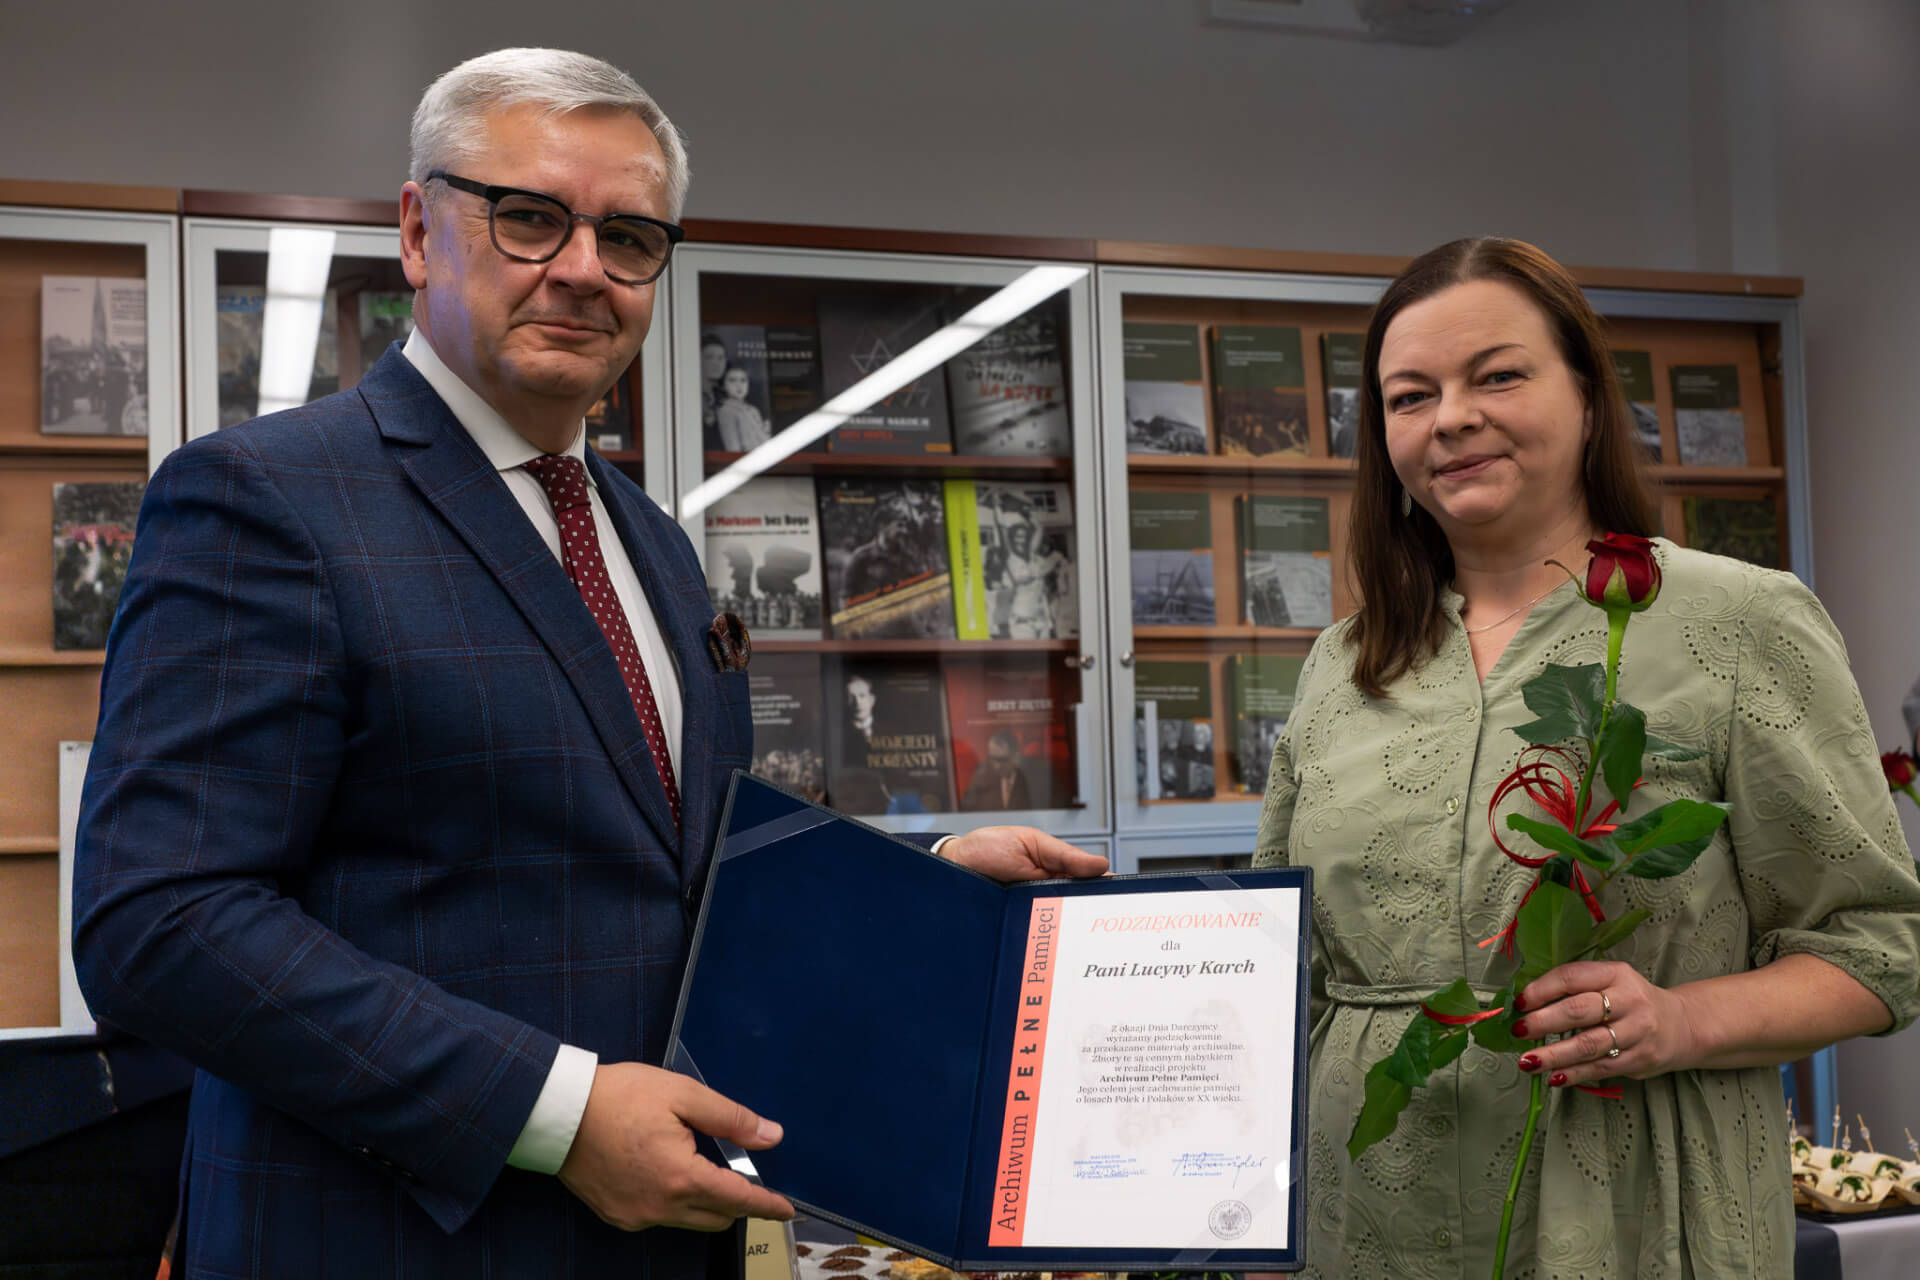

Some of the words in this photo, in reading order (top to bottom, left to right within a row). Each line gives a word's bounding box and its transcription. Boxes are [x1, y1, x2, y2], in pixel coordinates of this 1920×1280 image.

[870, 734, 937, 749] WOJCIECH
[1090, 911, 1263, 933] PODZIĘKOWANIE
[1027, 906, 1056, 984] Pamięci
[1161, 940, 1181, 951] dla
[1083, 962, 1127, 978] Pani
[1130, 962, 1196, 979] Lucyny
[1199, 959, 1256, 975] Karch
[1111, 1024, 1118, 1032] Z
[1119, 1024, 1146, 1033] okazji
[1148, 1023, 1169, 1031] Dnia
[1154, 1033, 1222, 1042] podziękowanie
[1014, 995, 1043, 1102] PEŁNE
[1093, 1045, 1145, 1054] przekazane
[1092, 1054, 1122, 1064] Zbiory
[1146, 1055, 1184, 1063] cennym
[1185, 1052, 1233, 1062] nabytkiem
[1124, 1064, 1166, 1073] realizacji
[1168, 1063, 1206, 1073] projektu
[1100, 1074, 1149, 1083] Archiwum
[1078, 1085, 1098, 1095] Jego
[1100, 1084, 1127, 1093] celem
[1129, 1085, 1145, 1094] jest
[1148, 1084, 1201, 1093] zachowanie
[1084, 1095, 1113, 1104] losach
[1115, 1095, 1140, 1103] Polek
[1147, 1094, 1184, 1103] Polaków
[1197, 1094, 1211, 1102] XX
[997, 1114, 1029, 1232] Archiwum
